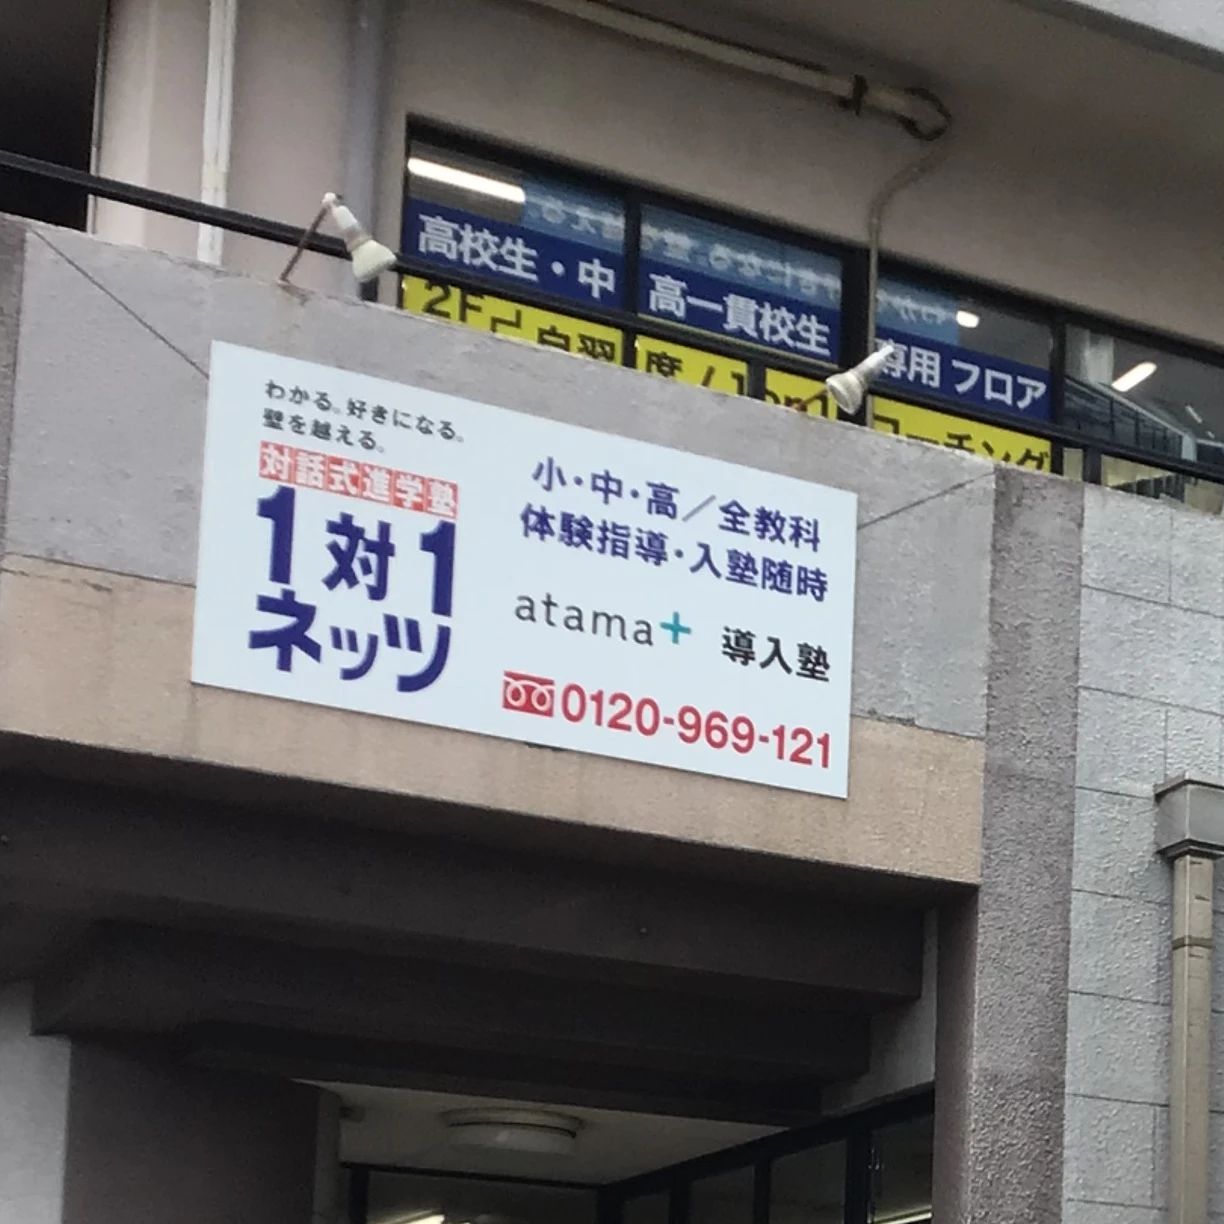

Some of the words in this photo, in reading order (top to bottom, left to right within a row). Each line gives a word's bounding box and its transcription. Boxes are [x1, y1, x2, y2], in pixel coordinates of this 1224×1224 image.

[418, 213, 616, 299] 高校生・中
[648, 273, 832, 357] 高一貫校生
[951, 358, 1047, 410] フロア
[260, 440, 458, 519] 対話式進学塾
[257, 484, 456, 618] 1対1
[520, 503, 829, 603] 体験指導・入塾随時
[248, 589, 452, 693] ネッツ
[721, 625, 832, 683] 導入塾
[560, 682, 832, 769] 0120-969-121
